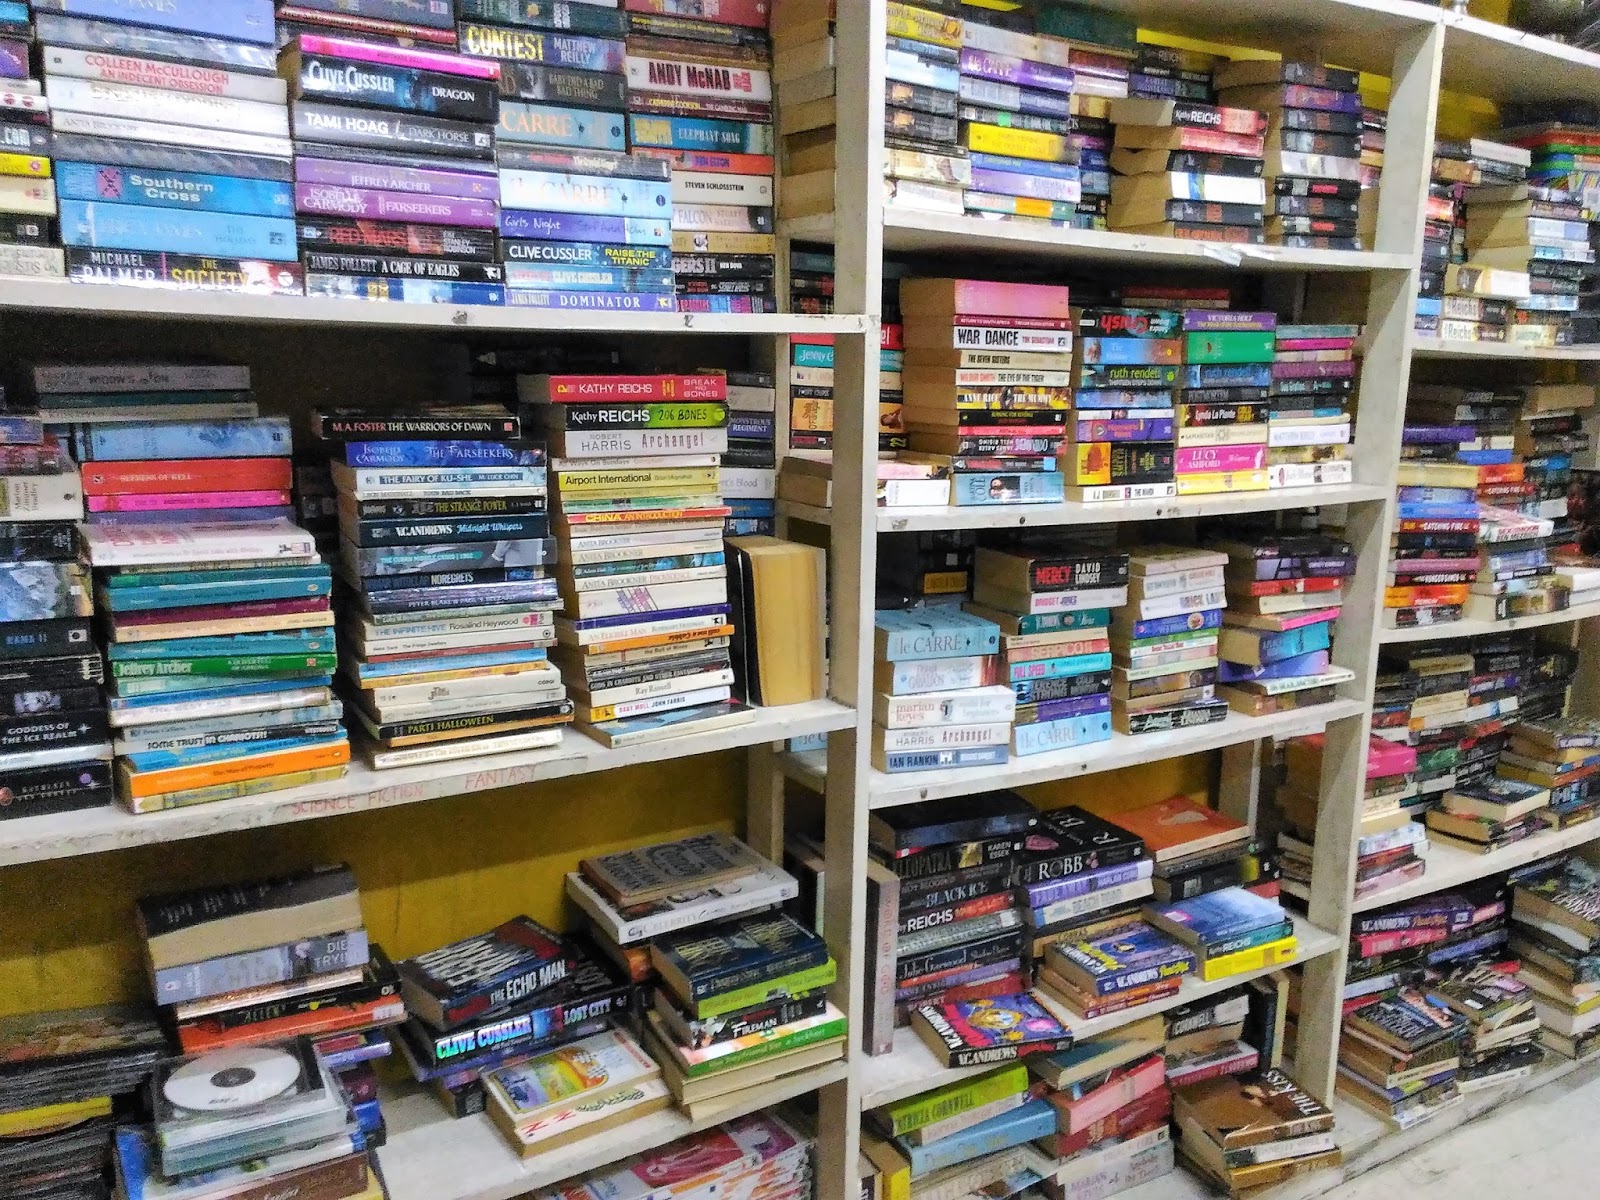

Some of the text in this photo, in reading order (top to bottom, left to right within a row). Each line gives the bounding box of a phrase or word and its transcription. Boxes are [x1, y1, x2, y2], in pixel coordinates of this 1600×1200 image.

[467, 26, 544, 61] CONTEST
[553, 38, 596, 53] MATTHEW
[560, 51, 591, 64] REILLY
[85, 54, 229, 85] COLLEEN McCULLOUGH
[649, 62, 731, 91] ANDY McNAB
[101, 69, 223, 94] AN INDECENT OBSESSION
[345, 66, 394, 93] CUSSLER
[432, 86, 475, 102] DRAGON
[1191, 111, 1221, 125] REICHS
[305, 112, 469, 142] TAMI HOAG DARK HORSE
[679, 128, 740, 144] ELEPHANT SONG
[130, 174, 214, 193] Southern
[351, 175, 431, 192] JEFFREY ARCHER
[685, 181, 705, 189] STEVEN
[145, 187, 201, 202] Cross
[304, 199, 451, 216] CARMODY FARSEEKERS
[679, 208, 712, 225] FALCON
[505, 217, 561, 236] Girls Night
[91, 252, 145, 267] MICHAEL
[509, 245, 656, 261] CLIVE CUSSLER RAISE THE
[201, 259, 218, 269] THE
[310, 256, 459, 277] JAMES FOLLETT A CAGE OF EAGLES
[611, 257, 650, 266] TITANIC
[81, 266, 154, 284] PALMER
[172, 269, 249, 287] SOCIETY
[560, 296, 641, 308] DOMINATOR
[1101, 314, 1148, 334] Crush
[958, 329, 1019, 346] WAR DANCE
[1448, 325, 1471, 340] Reichs
[799, 350, 825, 362] Jenny
[998, 374, 1006, 382] THE
[1110, 366, 1161, 379] ruth rendell
[579, 384, 614, 393] KATHY
[617, 383, 653, 393] REICHS
[571, 409, 707, 424] Kathy REICHS 206 BONES
[388, 422, 491, 432] THE WARRIORS OF DAWN
[733, 424, 767, 433] REGIMENT
[581, 432, 704, 451] HARRIS Archangel
[356, 454, 404, 464] CARMODY
[450, 445, 513, 459] FARSEEKERS
[1193, 449, 1219, 461] LUCY
[1188, 460, 1221, 469] ASHFORD
[384, 474, 473, 484] THE FAIRY OF KU-SHE
[566, 474, 651, 487] Airport International
[736, 479, 758, 488] Blood
[435, 500, 507, 513] THE STRANGE POWER
[585, 513, 621, 523] CHINA
[636, 511, 682, 520] INTRODUCTION
[457, 522, 523, 535] Midnight Whispers
[578, 540, 597, 549] ANITA
[579, 553, 602, 562] ANITA
[1035, 565, 1072, 585] MERCY
[1075, 562, 1101, 574] DAVID
[583, 576, 646, 589] ANITA BROOKNER
[450, 618, 519, 630] Rosalind Heywood
[652, 700, 665, 708] JOHN
[896, 701, 934, 713] marian
[8, 722, 69, 735] GODDESS OF
[437, 716, 494, 731] HALLOWEEN
[1, 731, 77, 744] THE ICE REALM
[176, 738, 203, 748] TRUST
[896, 729, 992, 747] HARRIS Archangel
[889, 754, 939, 768] IAN RANKIN
[465, 764, 537, 789] FANTASY
[291, 784, 424, 816] SCIENCE FICTION
[1039, 856, 1083, 880] ROBB
[925, 885, 966, 908] BLACK
[907, 909, 953, 931] REICHS
[327, 940, 347, 954] DIE
[491, 987, 505, 1005] THE
[506, 972, 538, 1002] ECHO
[540, 959, 566, 988] MAN
[436, 1032, 475, 1059] CLIVE
[477, 1016, 532, 1048] CUSSLER
[588, 998, 612, 1019] CITY
[931, 1092, 974, 1118] CORNWELL
